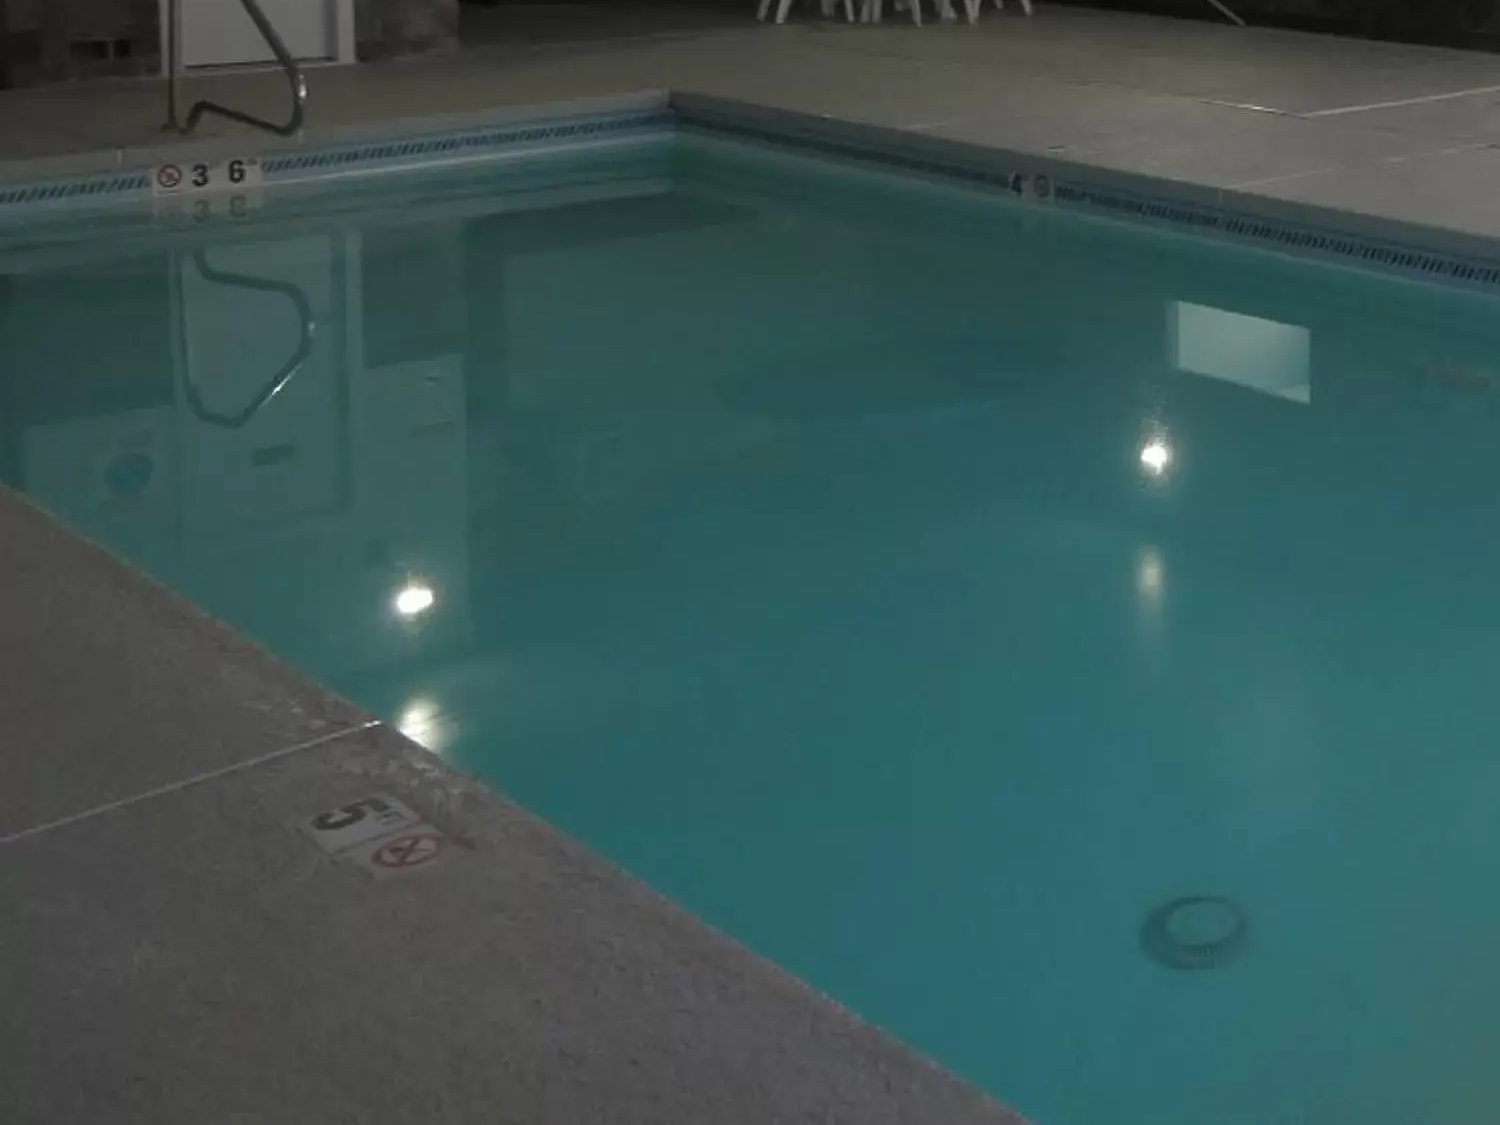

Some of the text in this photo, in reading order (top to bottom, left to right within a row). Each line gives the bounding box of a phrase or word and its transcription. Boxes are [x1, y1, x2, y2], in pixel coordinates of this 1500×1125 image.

[191, 159, 246, 187] 3 6
[310, 797, 392, 830] 5
